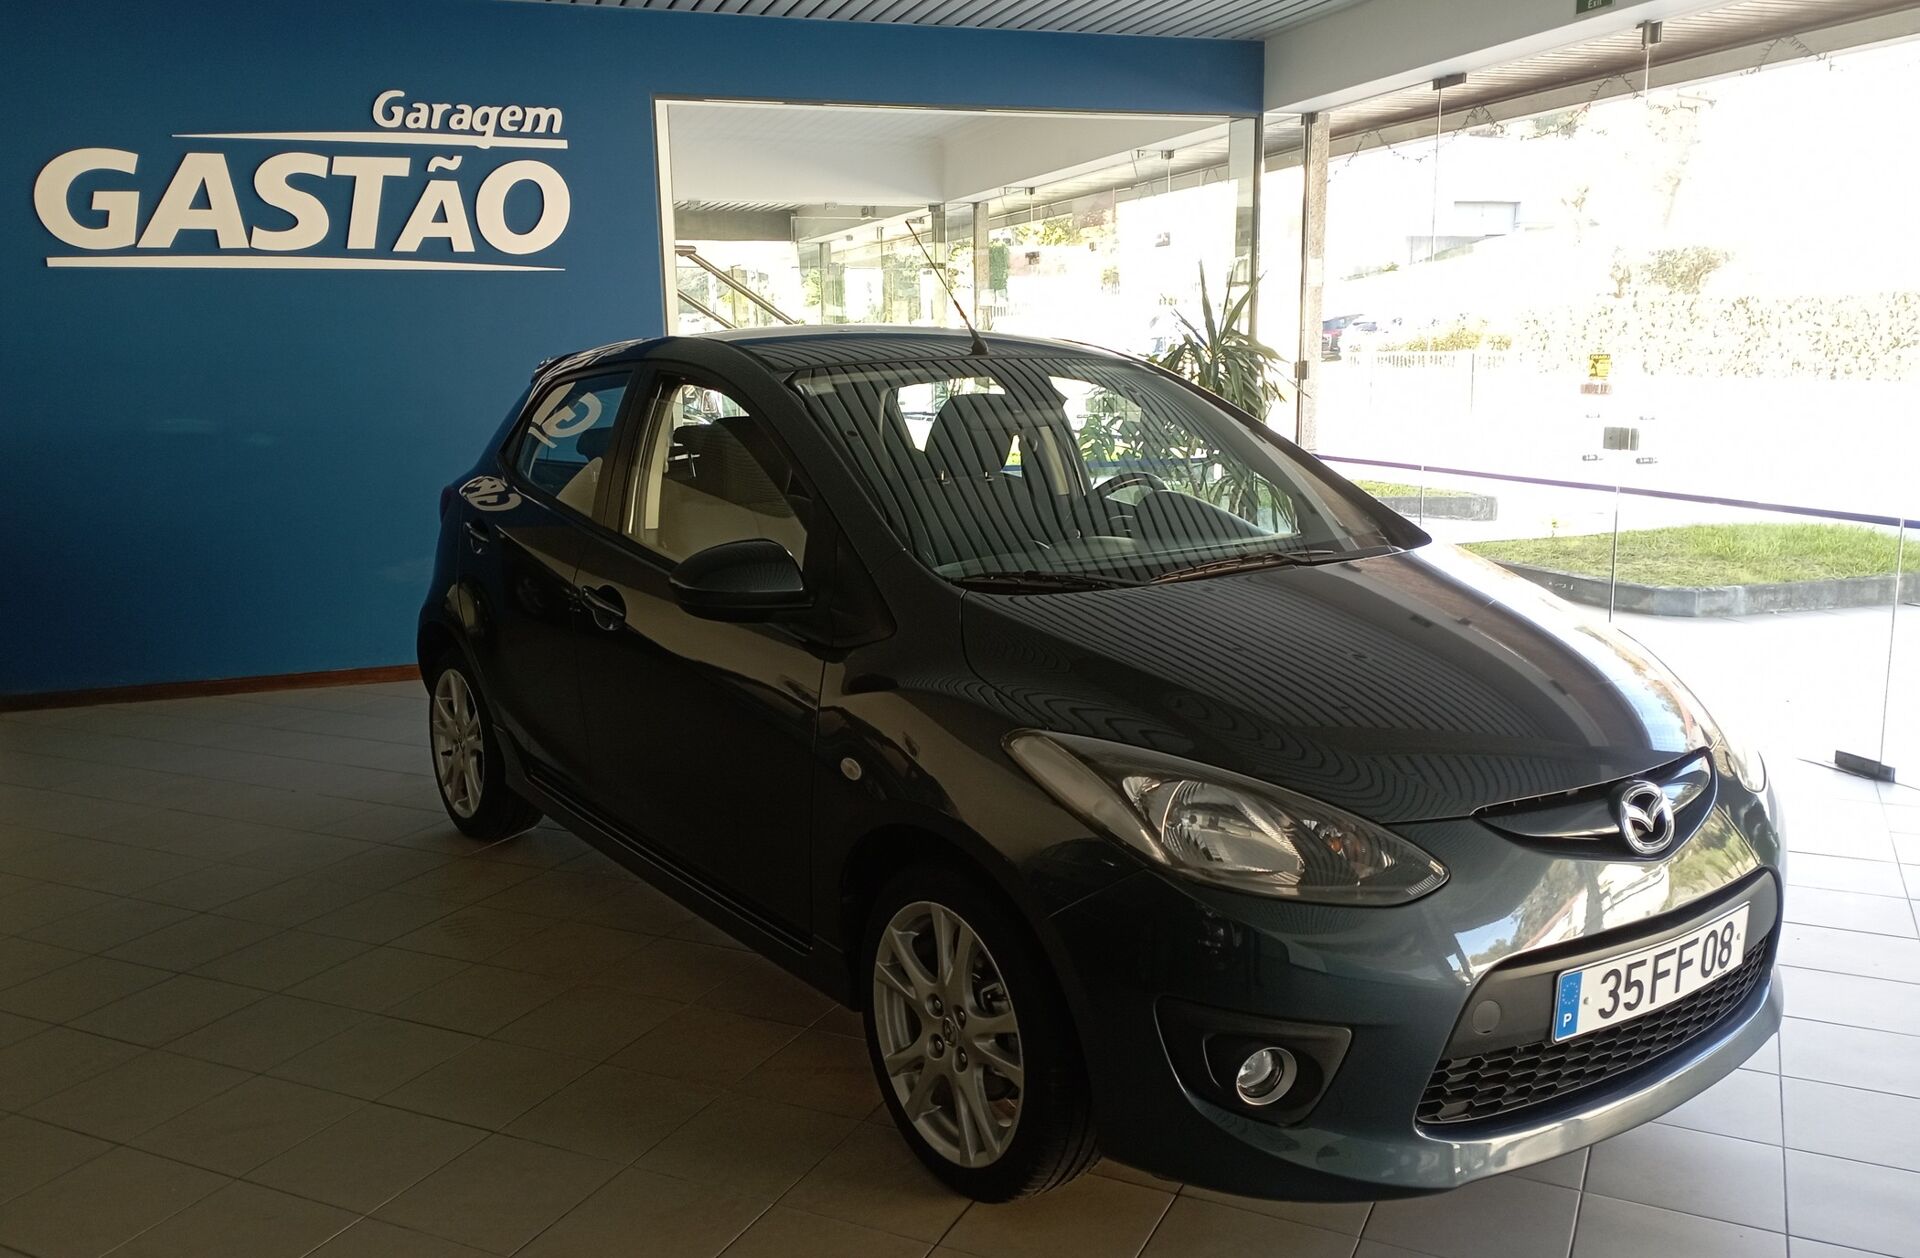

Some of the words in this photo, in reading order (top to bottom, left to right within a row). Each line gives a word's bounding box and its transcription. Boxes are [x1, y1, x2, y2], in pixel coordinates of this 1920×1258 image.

[372, 90, 562, 149] Garagem
[34, 147, 570, 255] GASTÃO
[1563, 1013, 1572, 1028] P
